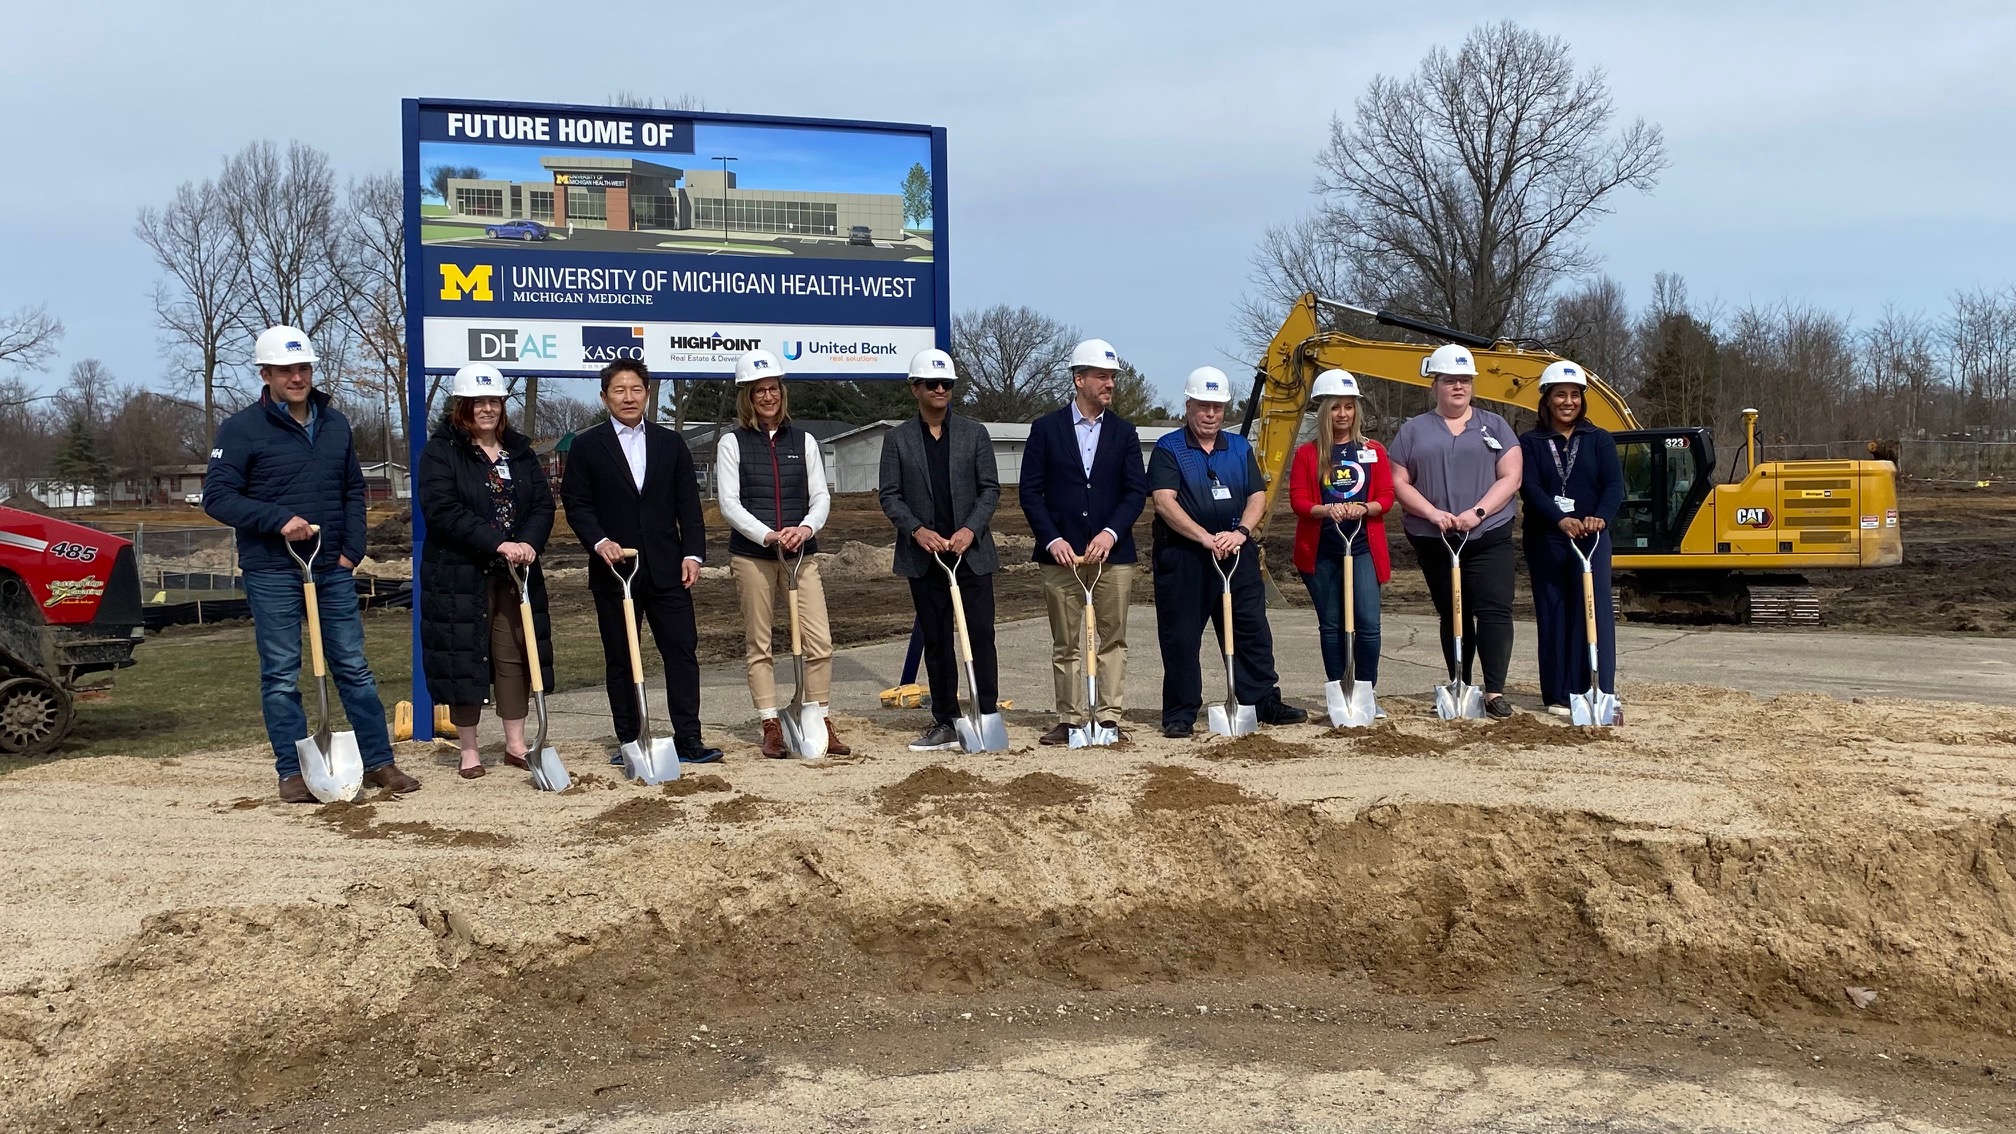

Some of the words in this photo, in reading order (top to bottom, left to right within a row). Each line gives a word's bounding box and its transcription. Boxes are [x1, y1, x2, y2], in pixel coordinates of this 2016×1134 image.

[448, 113, 550, 140] FUTURE
[558, 118, 634, 145] HOME
[641, 122, 674, 147] OF
[556, 175, 569, 184] M
[439, 263, 494, 301] M
[512, 266, 636, 291] UNIVERSITY
[642, 269, 668, 292] OF
[672, 271, 775, 295] MICHIGAN
[781, 274, 916, 298] HEALTH-WEST
[512, 291, 583, 303] MICHIGAN
[588, 293, 653, 305] MEDICINE
[480, 333, 557, 359] DHAE
[670, 336, 761, 351] HIGHPOINT
[809, 341, 857, 354] United
[861, 342, 897, 355] Bank
[582, 345, 644, 361] KASCO
[670, 354, 686, 362] Real
[688, 354, 710, 362] Estate
[1665, 438, 1684, 448] 323
[1337, 469, 1351, 478] M
[1737, 508, 1765, 525] CAT
[49, 541, 98, 563] 485
